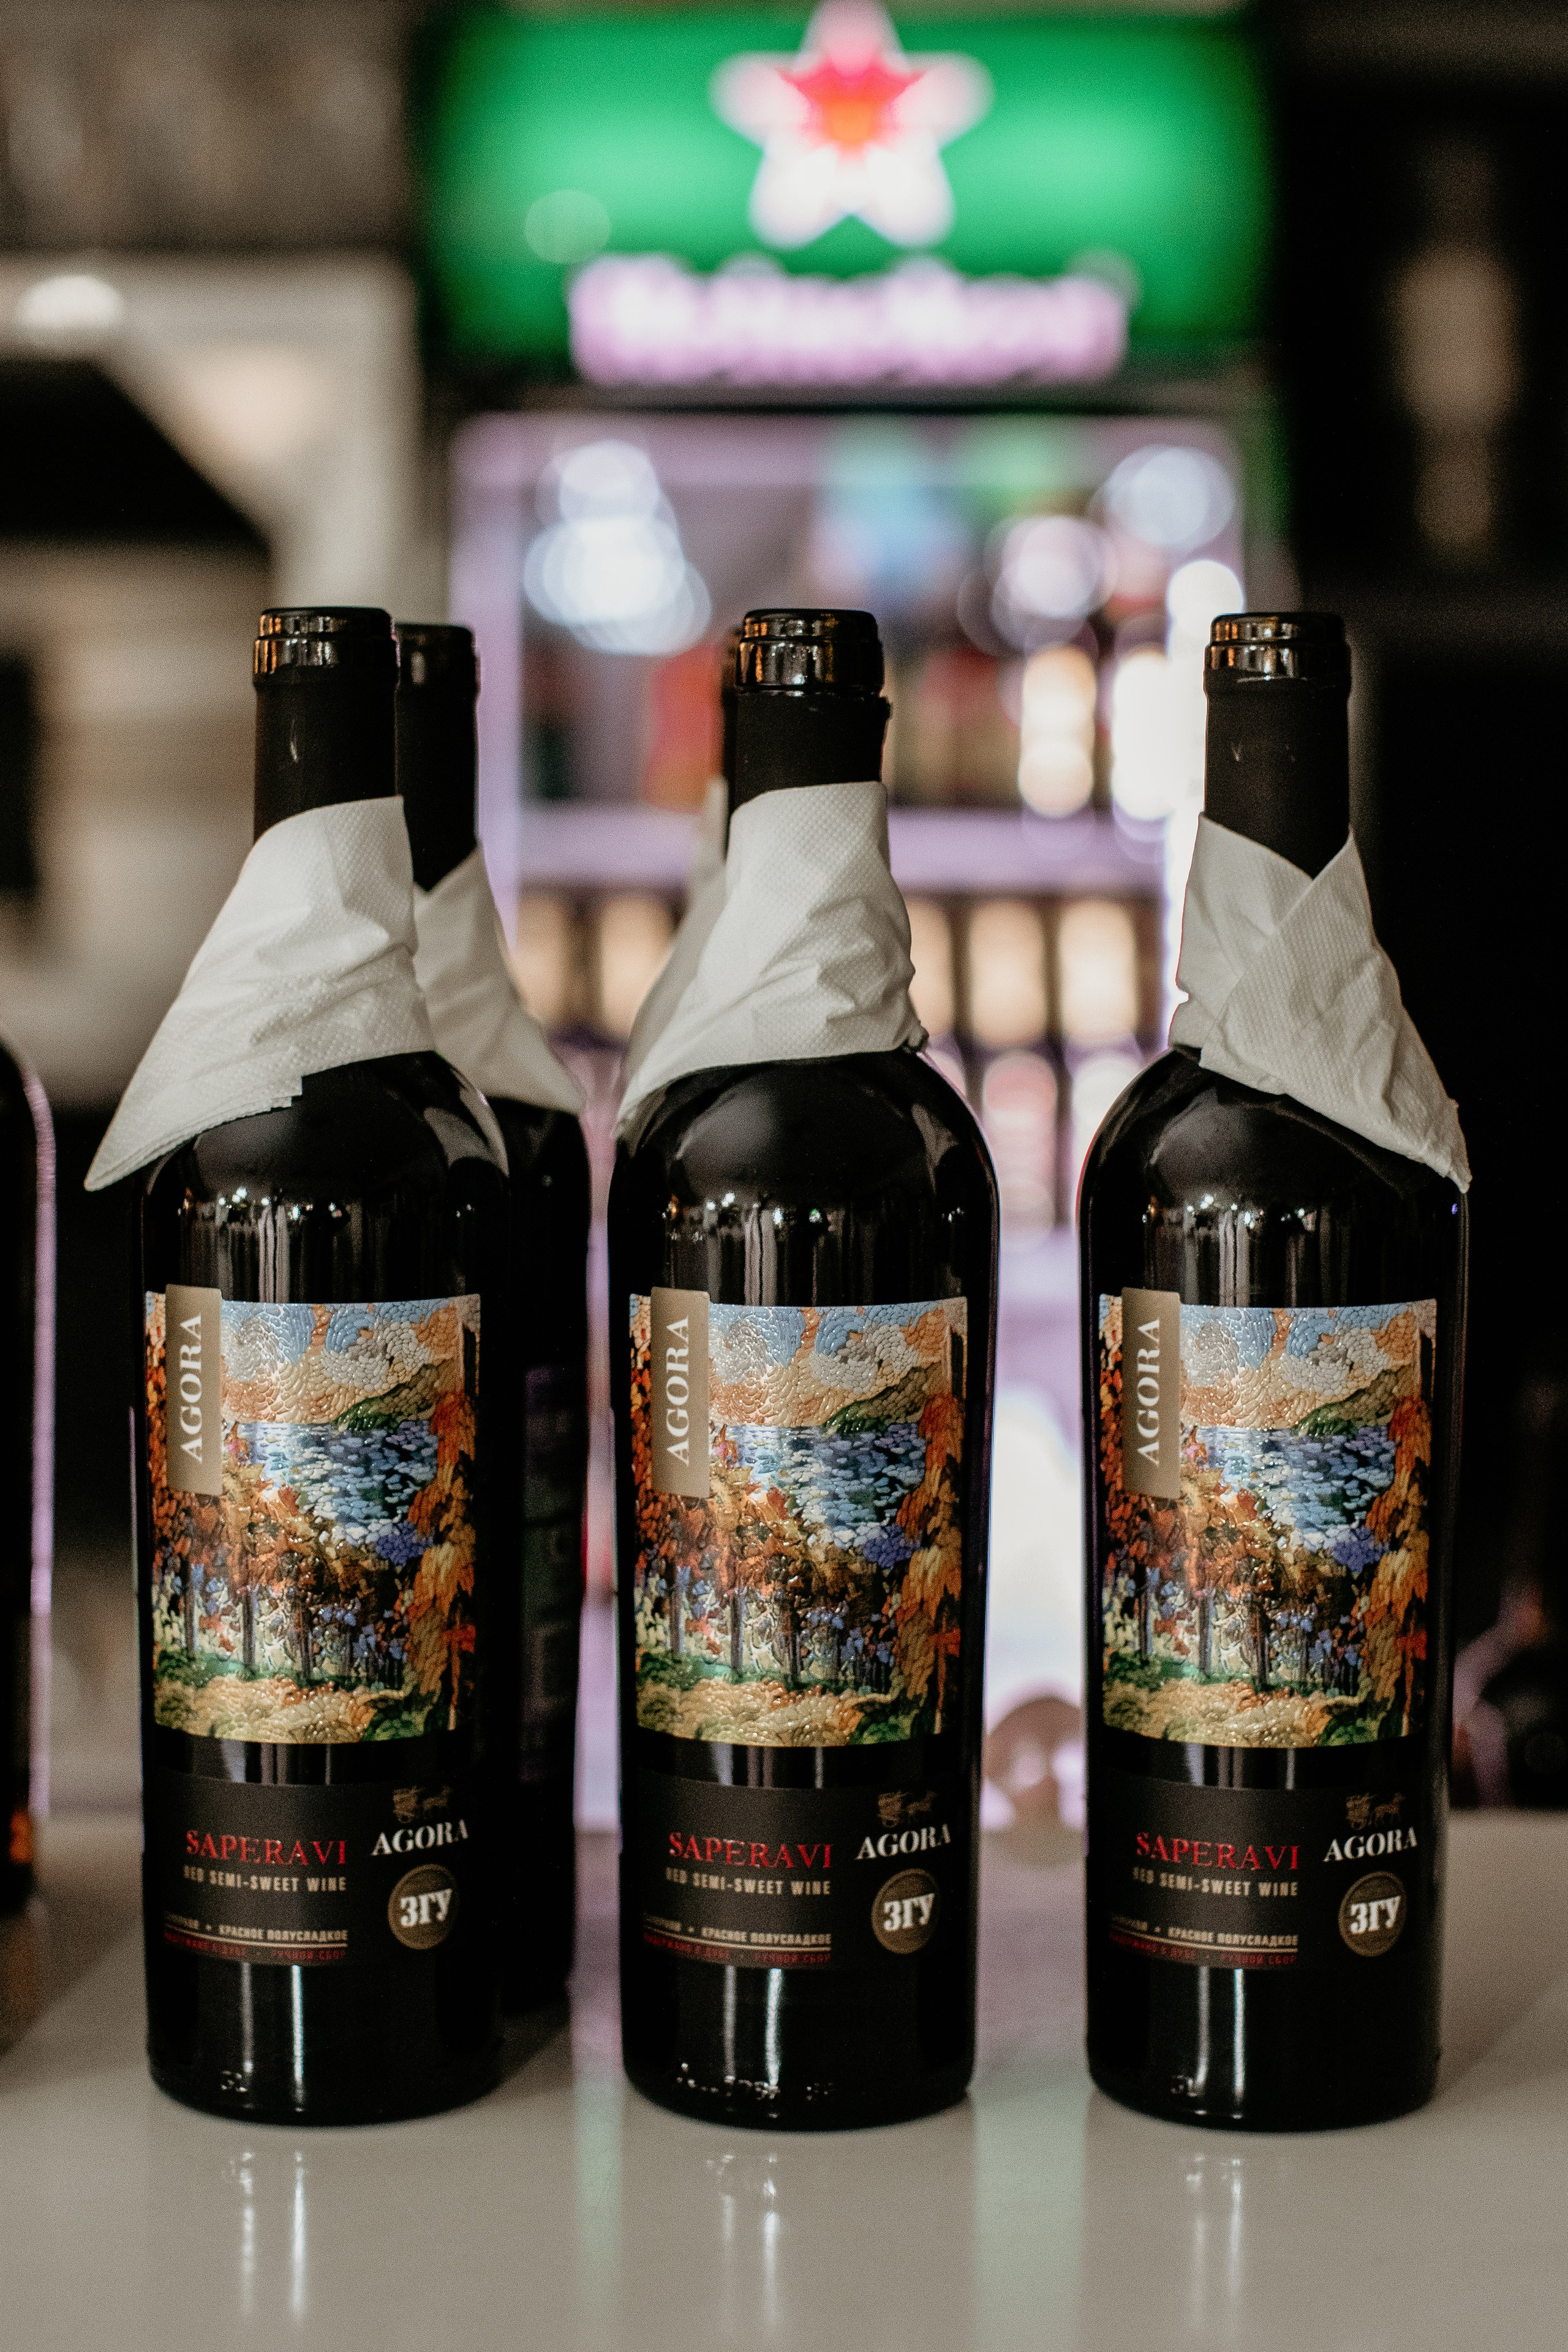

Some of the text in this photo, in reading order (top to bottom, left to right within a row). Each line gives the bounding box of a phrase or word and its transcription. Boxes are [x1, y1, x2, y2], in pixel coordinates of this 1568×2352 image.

[180, 1313, 203, 1465] AGORA
[666, 1316, 690, 1467] AGORA
[1137, 1317, 1161, 1467] AGORA
[186, 1830, 347, 1865] SAPERAVI
[371, 1819, 468, 1856] AGORA
[669, 1832, 832, 1868] SAPERAVI
[856, 1823, 951, 1860] AGORA
[1136, 1832, 1299, 1870] SAPERAVI
[1323, 1826, 1418, 1863] AGORA
[210, 1869, 299, 1893] SEMI-SWEET
[306, 1876, 346, 1892] WINE
[693, 1872, 783, 1894] SEMI-SWEET
[790, 1880, 831, 1895] WINE
[1161, 1872, 1251, 1896] SEMI-SWEET
[1258, 1881, 1297, 1897] WINE
[399, 1888, 451, 1928] ЗГУ
[883, 1893, 935, 1932] ЗГУ
[1350, 1896, 1401, 1934] ЗГУ
